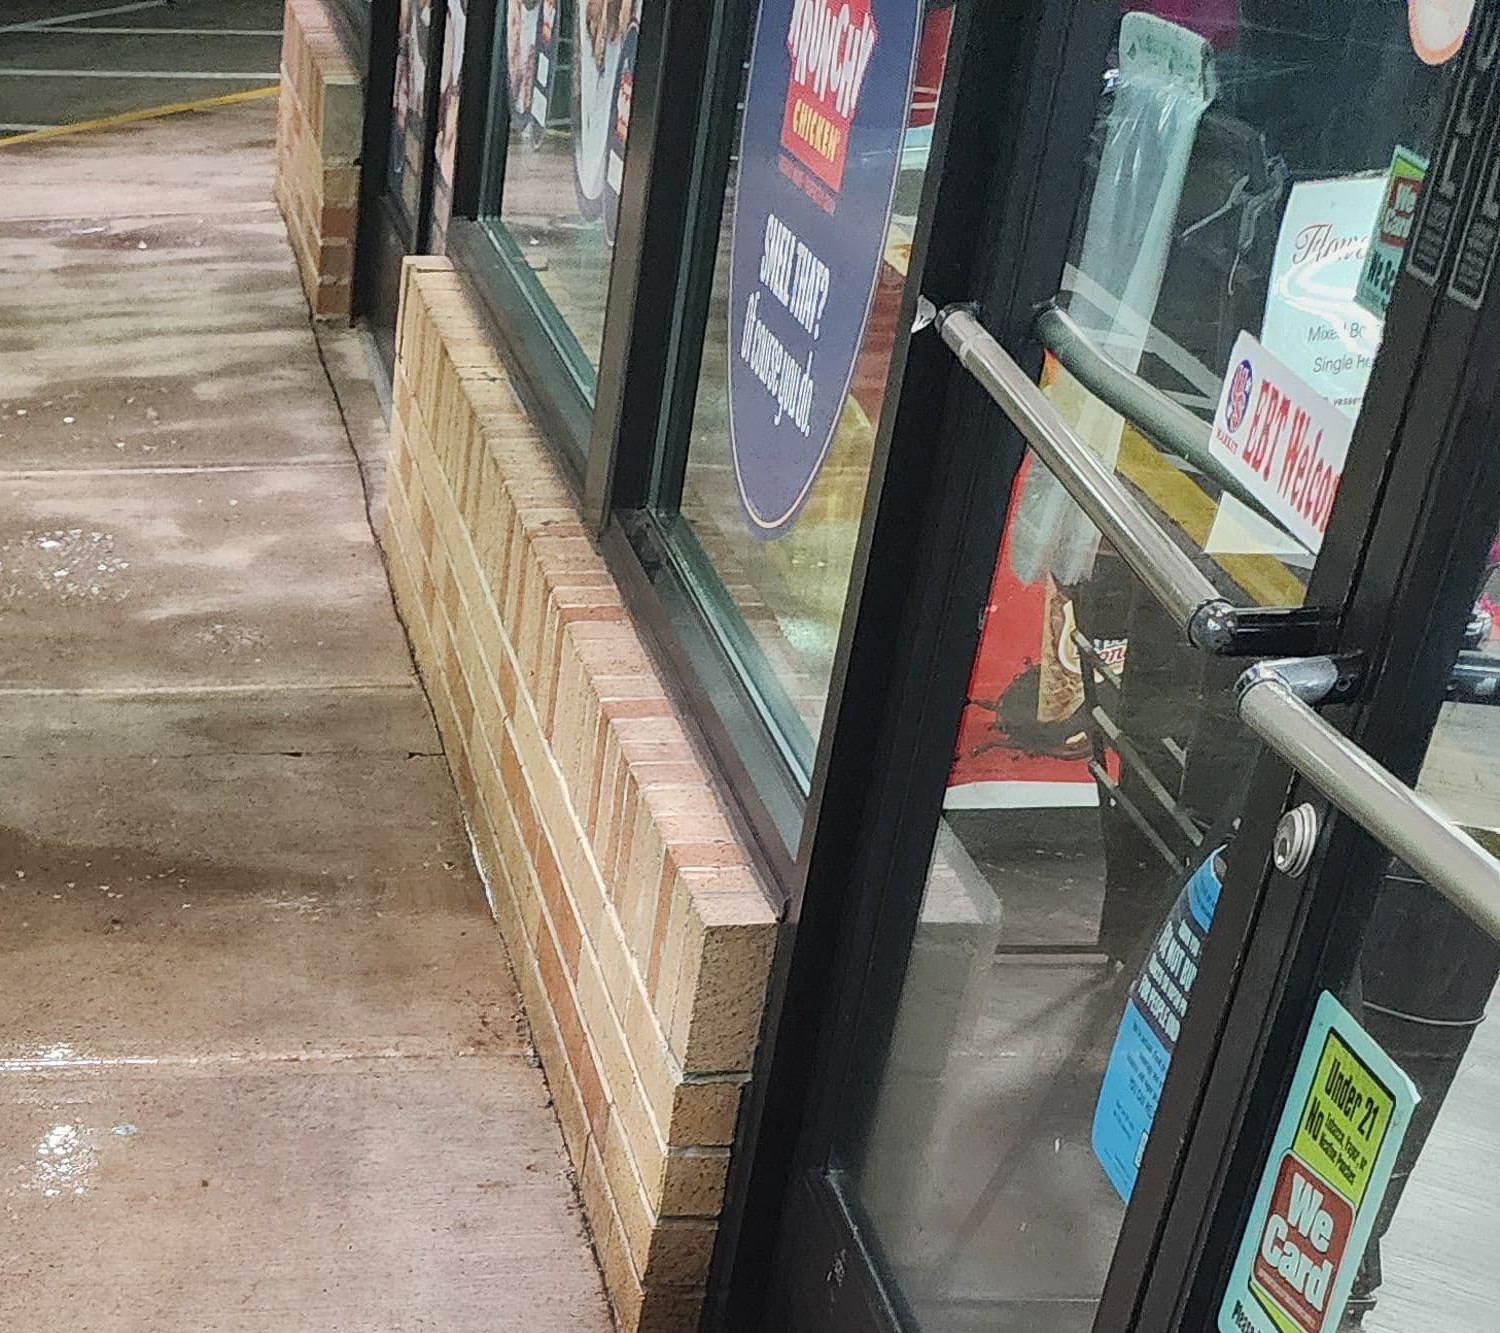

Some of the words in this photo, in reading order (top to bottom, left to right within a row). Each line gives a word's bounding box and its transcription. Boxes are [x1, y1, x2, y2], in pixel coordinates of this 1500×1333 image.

[793, 98, 841, 164] CHICKEN
[760, 213, 797, 308] SMELL
[789, 241, 830, 341] THAT?
[740, 290, 761, 363] Of
[750, 318, 784, 397] course
[1313, 354, 1353, 375] Single
[772, 350, 802, 427] you
[795, 350, 815, 438] do.
[1241, 379, 1291, 482] EBT
[1304, 1096, 1324, 1141] No
[1325, 1058, 1362, 1121] Under
[1357, 1097, 1380, 1141] 21
[1287, 1172, 1334, 1253] We
[1262, 1213, 1333, 1313] Card
